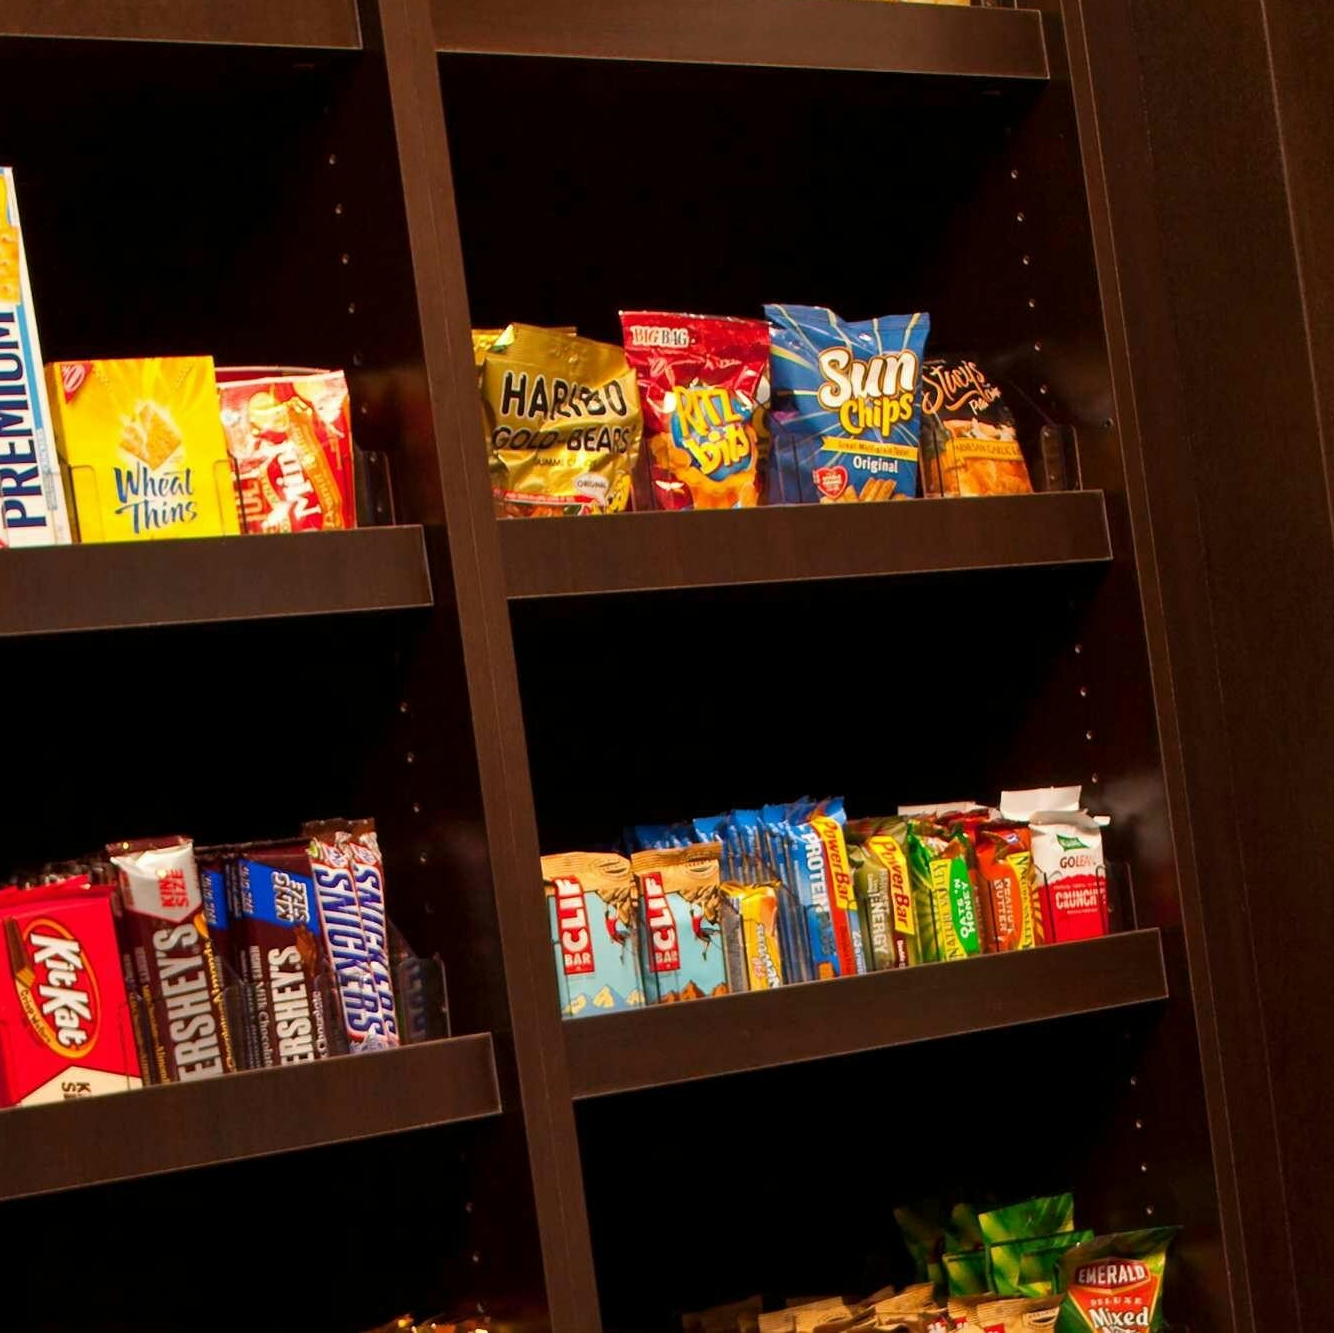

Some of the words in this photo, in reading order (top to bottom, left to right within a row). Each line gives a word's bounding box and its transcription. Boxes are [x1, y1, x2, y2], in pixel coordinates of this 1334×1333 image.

[633, 326, 660, 343] BIG
[660, 328, 689, 346] BAG
[500, 370, 628, 421] HARIBO
[818, 346, 917, 412] Sun
[672, 385, 743, 438] RITZ
[839, 391, 915, 438] Chips
[113, 465, 195, 503] Wheat
[852, 455, 898, 474] Original
[115, 498, 198, 535] Thins
[157, 869, 178, 910] KIN
[169, 868, 190, 908] SIZE
[801, 828, 831, 914] PROTEIN
[271, 871, 294, 922] KING
[289, 880, 311, 924] SIZE
[556, 876, 589, 951] CLIF
[645, 871, 677, 951] CLIF
[869, 897, 889, 955] ENERGY
[313, 866, 385, 1038] SNICKERS
[564, 951, 592, 966] BAR
[654, 950, 679, 964] BAR
[152, 923, 225, 1083] ERSHEY'S
[267, 945, 317, 1067] ERSHEY'S
[1078, 1263, 1147, 1285] EMERALD
[1088, 1306, 1150, 1329] Mixed
